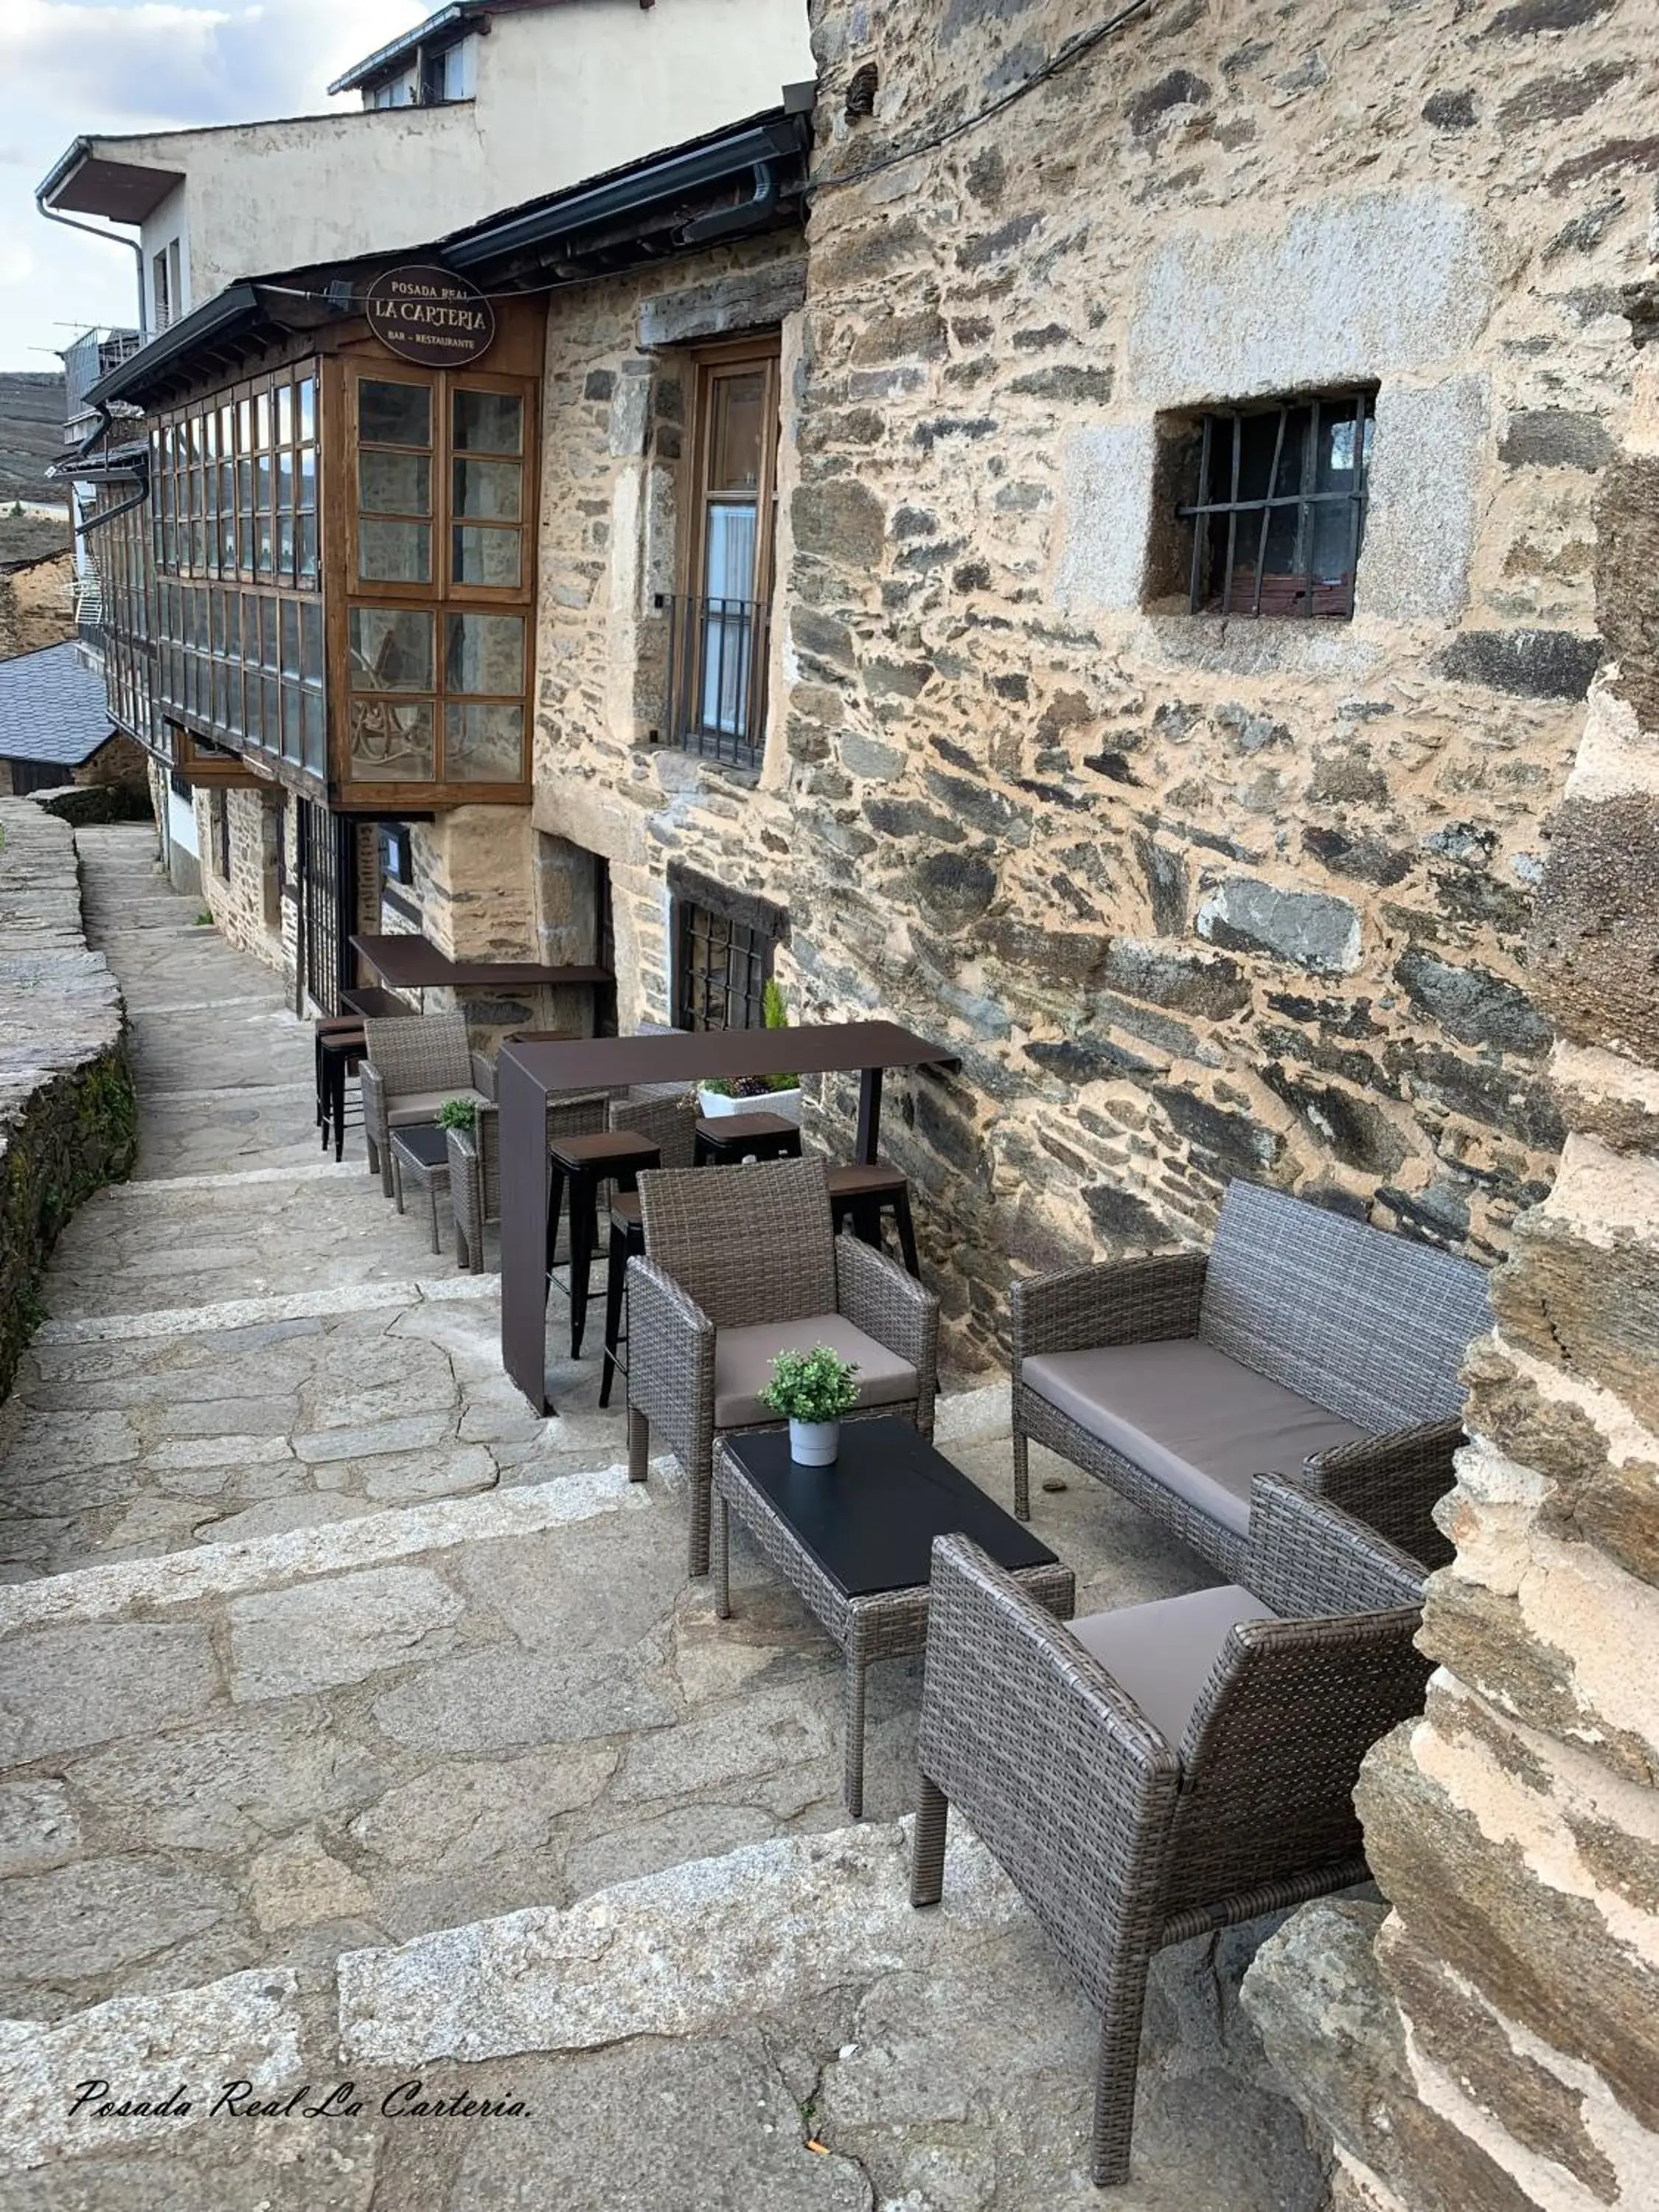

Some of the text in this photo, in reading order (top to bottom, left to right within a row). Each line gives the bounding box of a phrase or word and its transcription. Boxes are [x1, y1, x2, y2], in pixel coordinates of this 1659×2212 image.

[391, 281, 437, 297] POSADA
[375, 300, 487, 330] LA CARTERIA
[388, 330, 406, 340] BAR
[415, 335, 476, 349] RESTAURANTE
